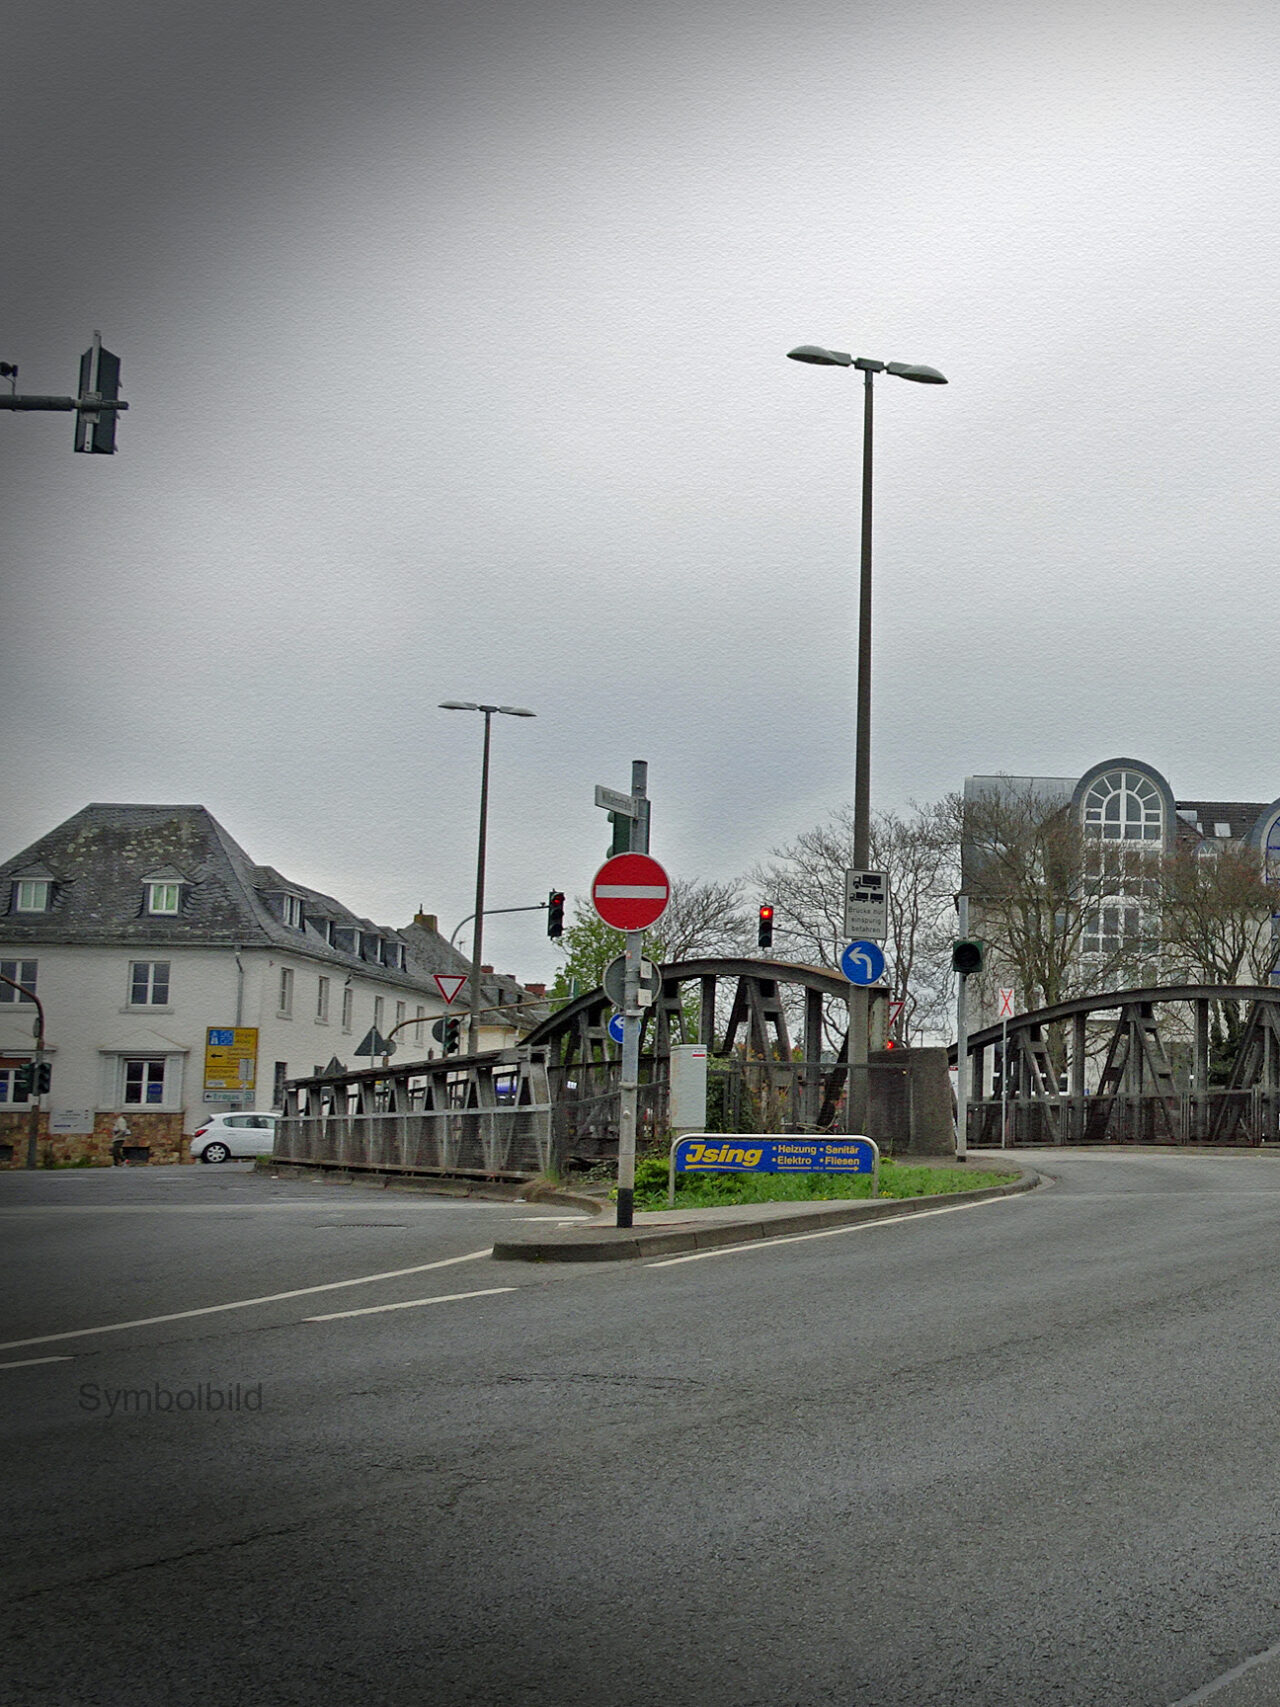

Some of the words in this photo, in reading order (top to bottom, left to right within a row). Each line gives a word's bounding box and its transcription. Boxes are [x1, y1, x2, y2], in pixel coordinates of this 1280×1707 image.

[778, 1144, 817, 1155] Heizung
[825, 1145, 860, 1154] Sanitär
[777, 1156, 812, 1164] Elektro
[825, 1156, 860, 1165] Fliesen
